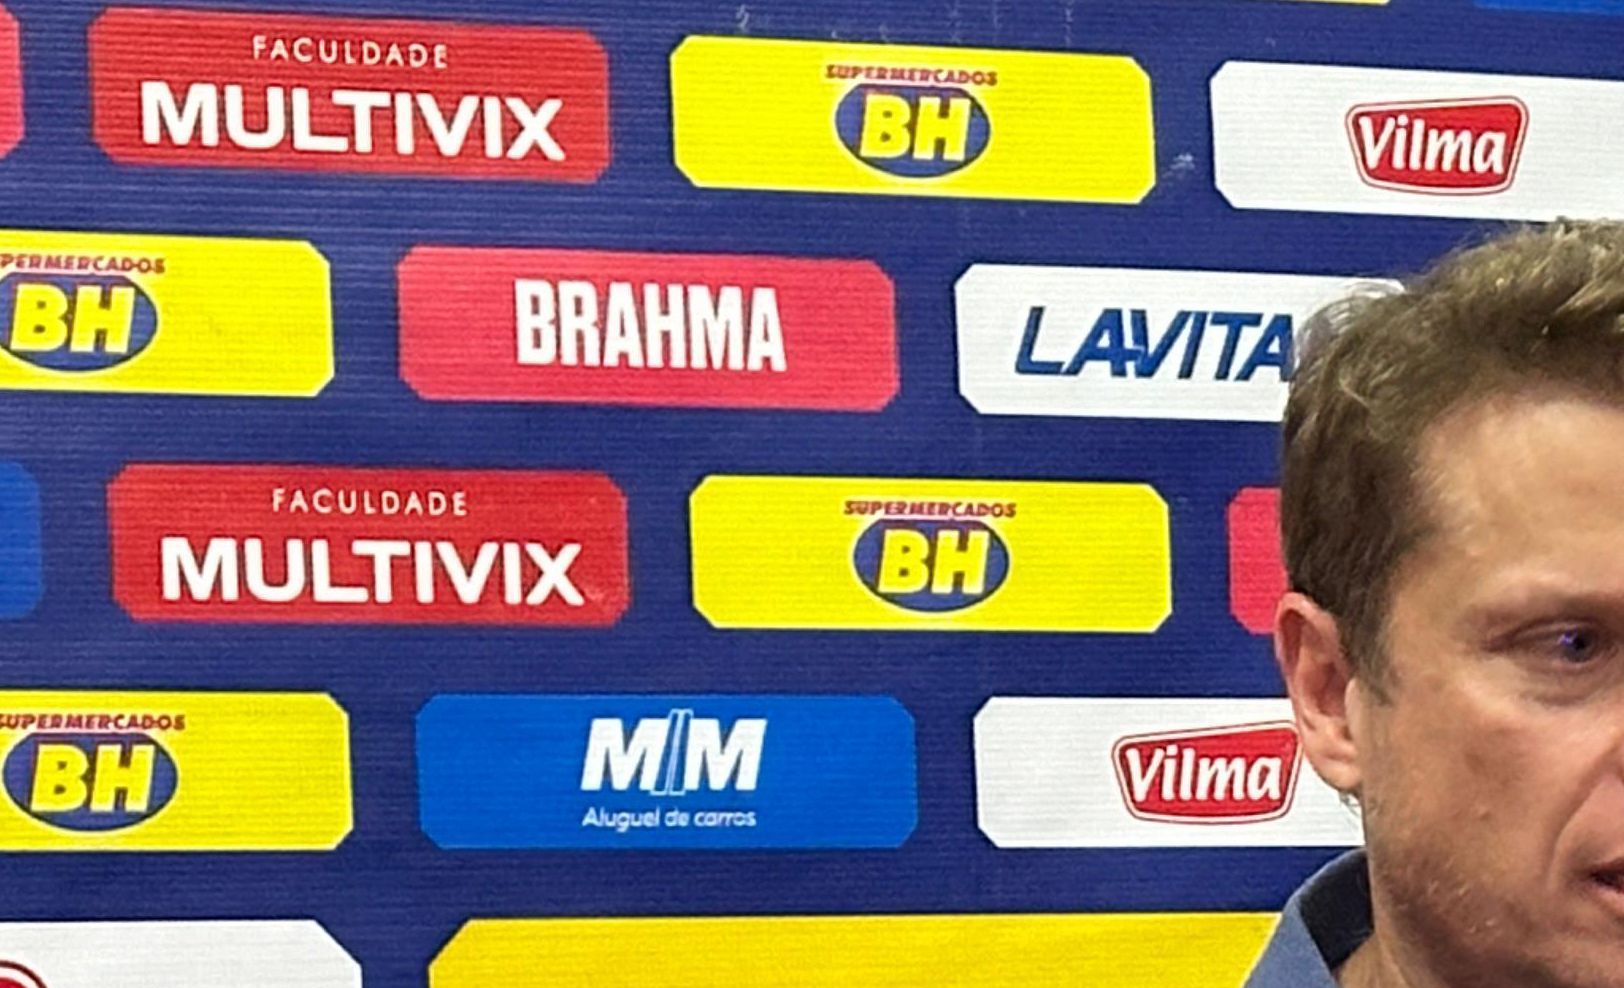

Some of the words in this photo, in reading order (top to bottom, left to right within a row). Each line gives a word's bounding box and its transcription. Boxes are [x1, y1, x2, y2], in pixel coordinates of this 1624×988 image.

[252, 35, 448, 68] FACULDADE
[826, 64, 998, 86] SUPERMERCADOS
[140, 81, 565, 160] MULTIVIX
[859, 93, 971, 161] BH
[1359, 114, 1506, 174] Vilma
[10, 283, 135, 354] BH
[514, 279, 786, 372] BRAHMA
[272, 488, 468, 516] FACULDADE
[844, 500, 1016, 517] SUPERMERCADOS
[160, 536, 585, 605] MULTIVIX
[878, 529, 990, 594] BH
[30, 744, 154, 812] BH
[1126, 744, 1282, 802] Vilma
[582, 806, 660, 833] Aluguel
[664, 806, 690, 827] de
[694, 811, 757, 827] carros
